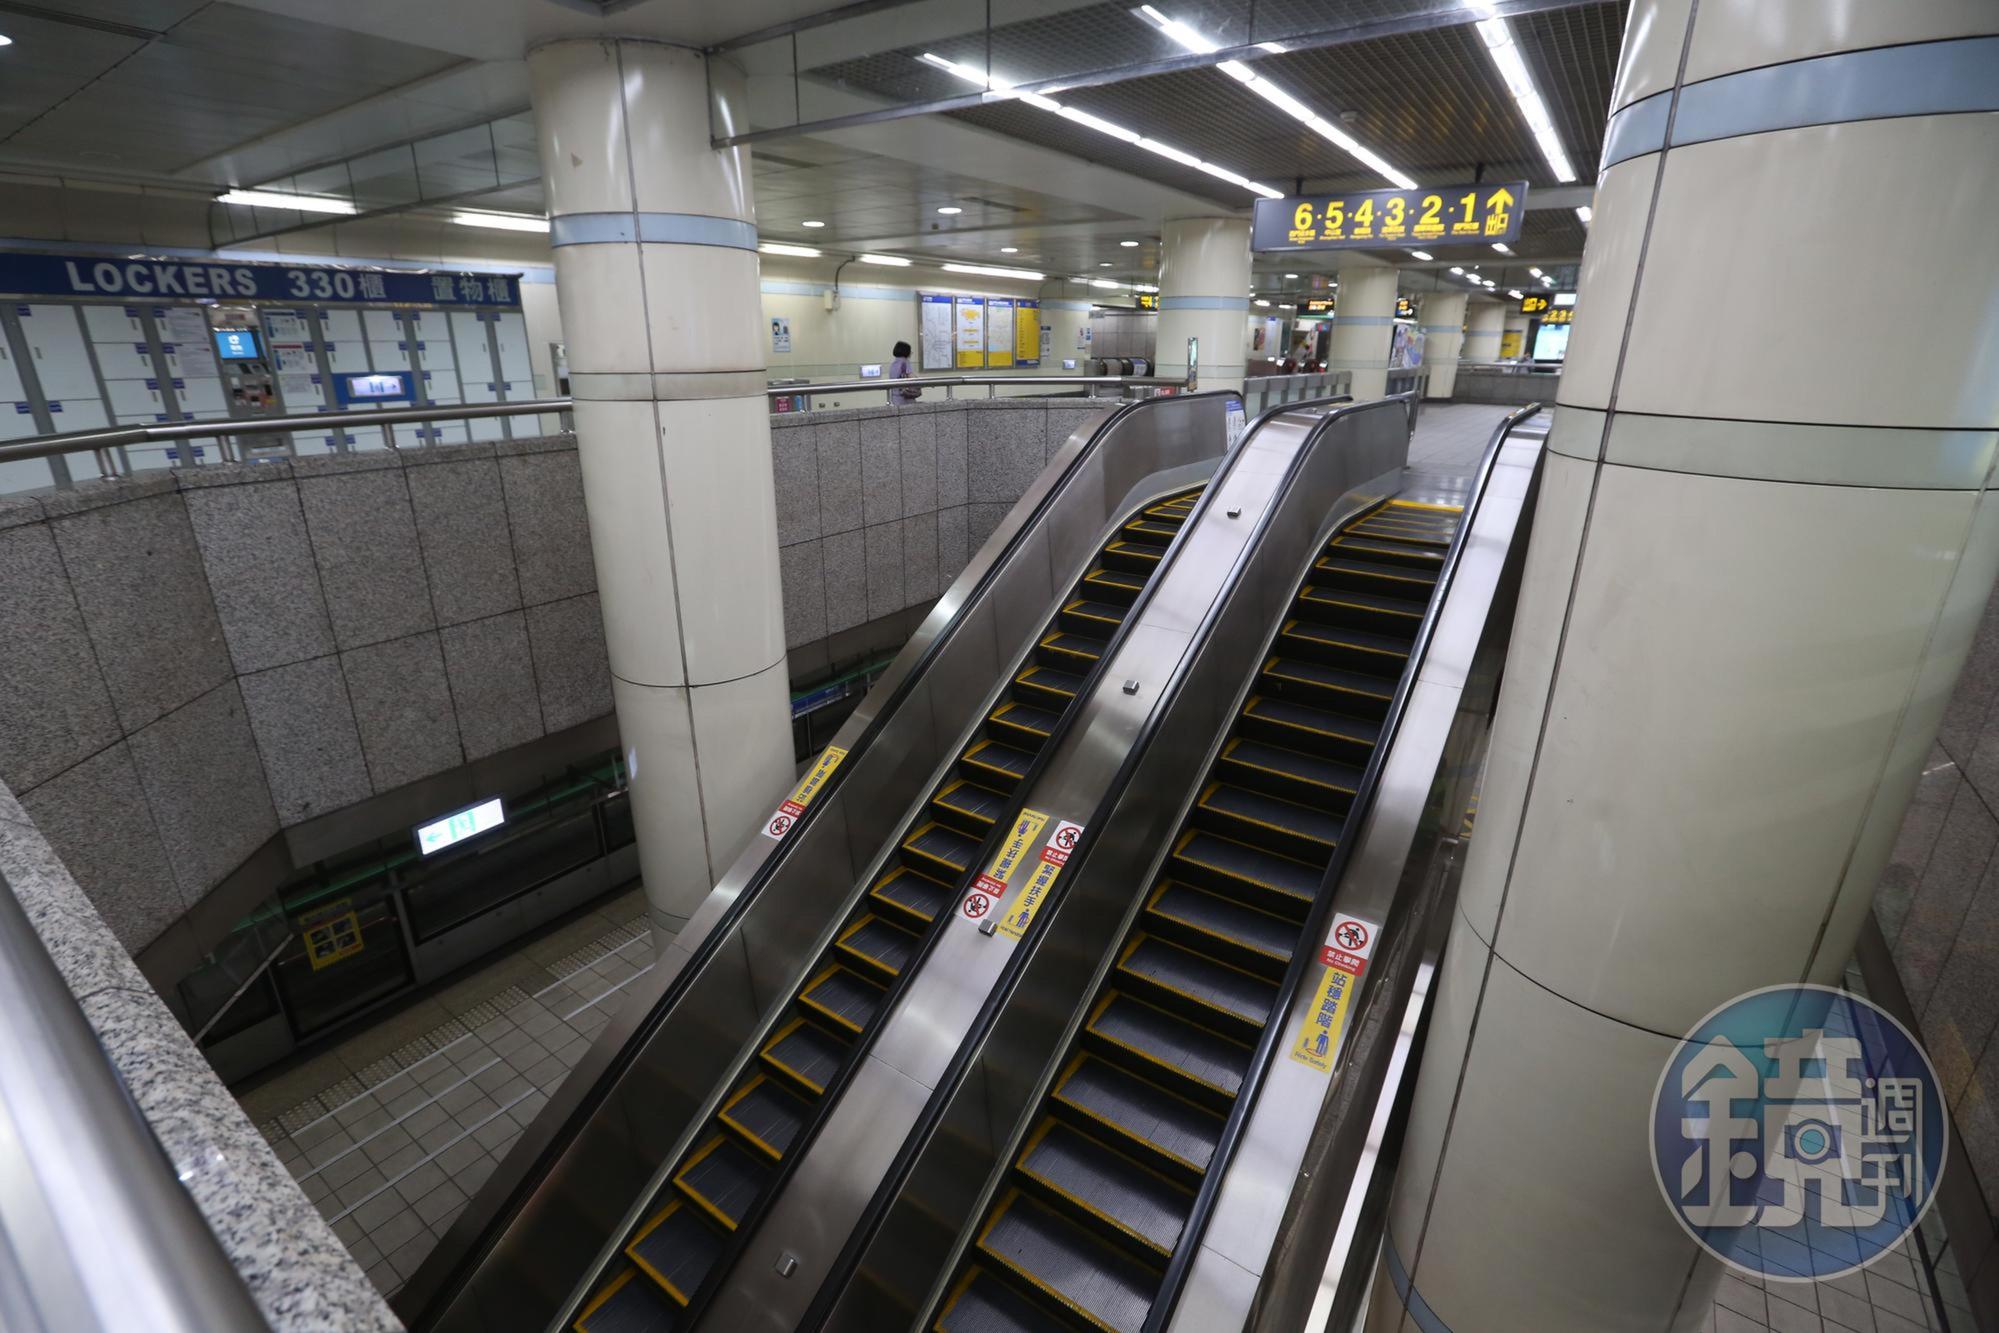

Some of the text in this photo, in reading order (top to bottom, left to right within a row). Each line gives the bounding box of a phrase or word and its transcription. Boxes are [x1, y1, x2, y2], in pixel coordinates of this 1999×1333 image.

[1484, 213, 1510, 236] 出口
[65, 261, 257, 296] LOCKERS
[431, 275, 512, 302] 置物櫃
[1315, 972, 1348, 1029] 站穩踏階
